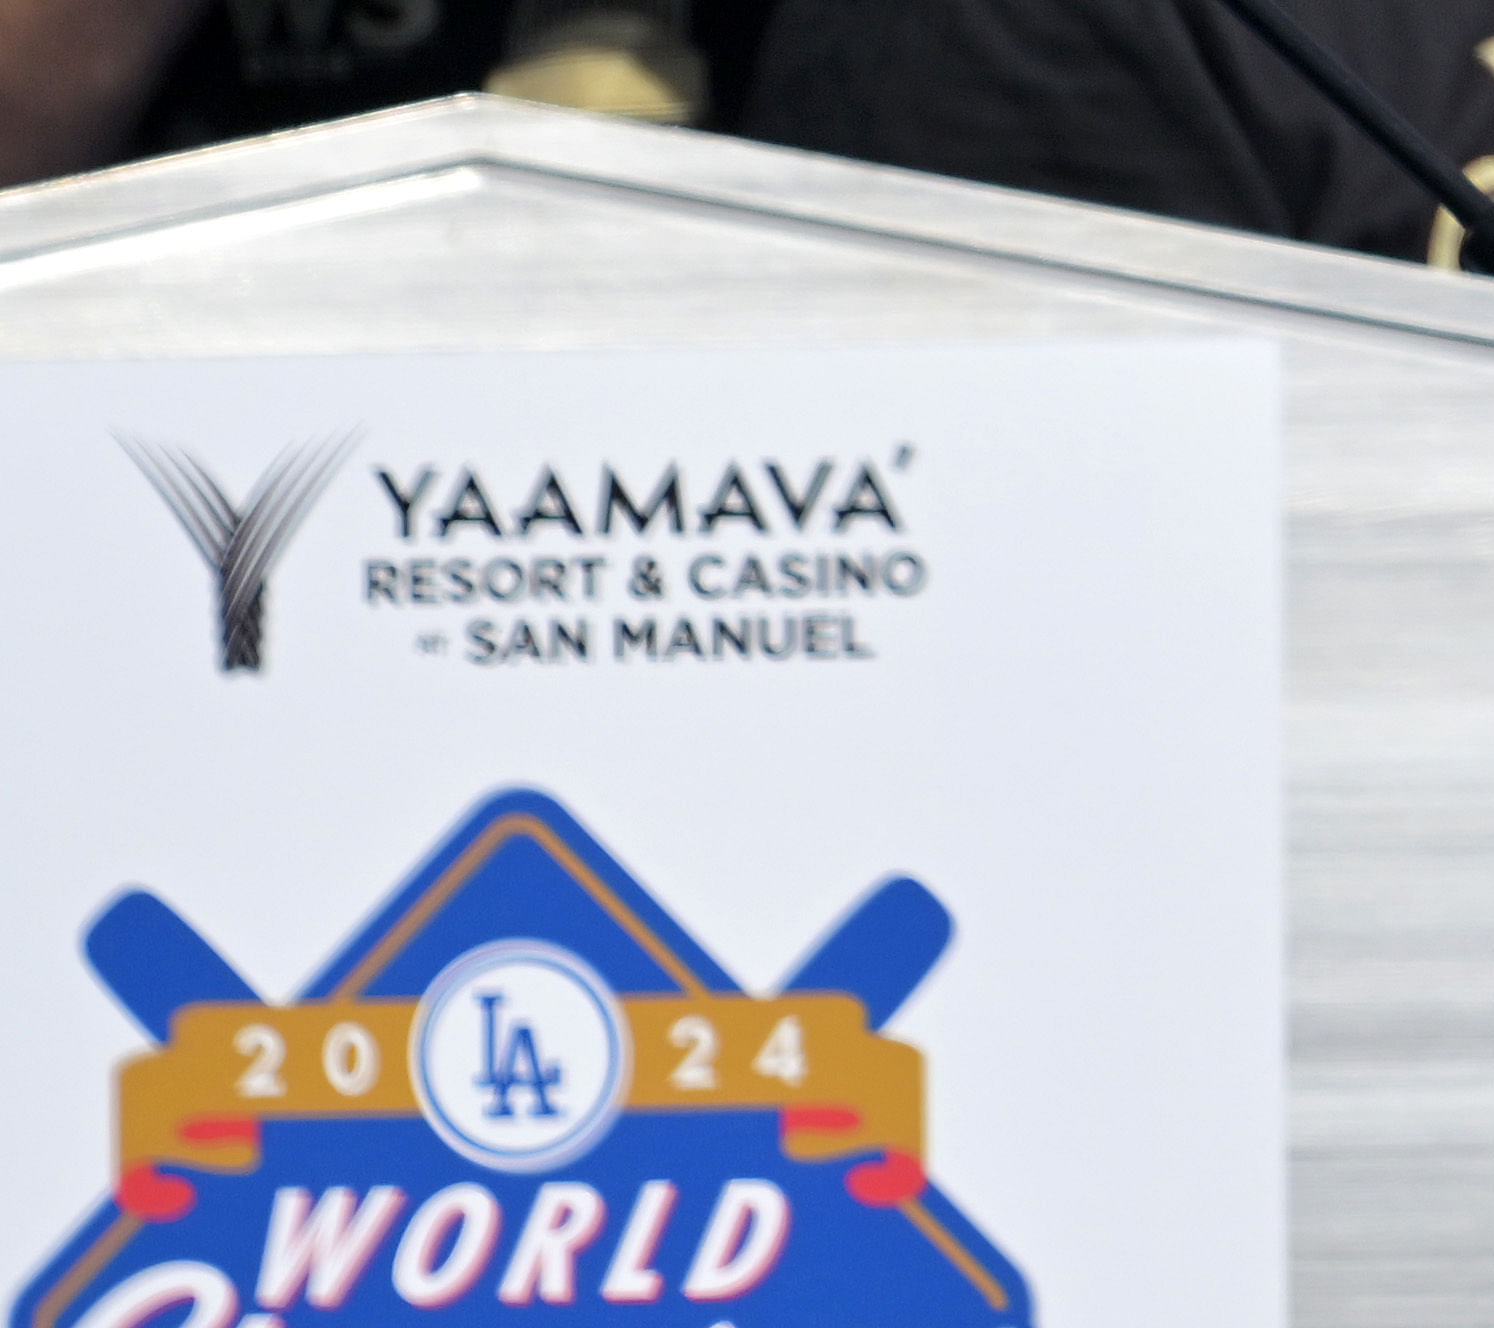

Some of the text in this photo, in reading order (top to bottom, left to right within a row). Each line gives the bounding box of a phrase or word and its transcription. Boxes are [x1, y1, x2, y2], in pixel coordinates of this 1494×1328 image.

[363, 551, 927, 606] RESORT & CASINO
[464, 617, 592, 664] SAN
[613, 613, 876, 661] MANUEL
[472, 992, 564, 1120] LA
[256, 1178, 792, 1308] WORLD
